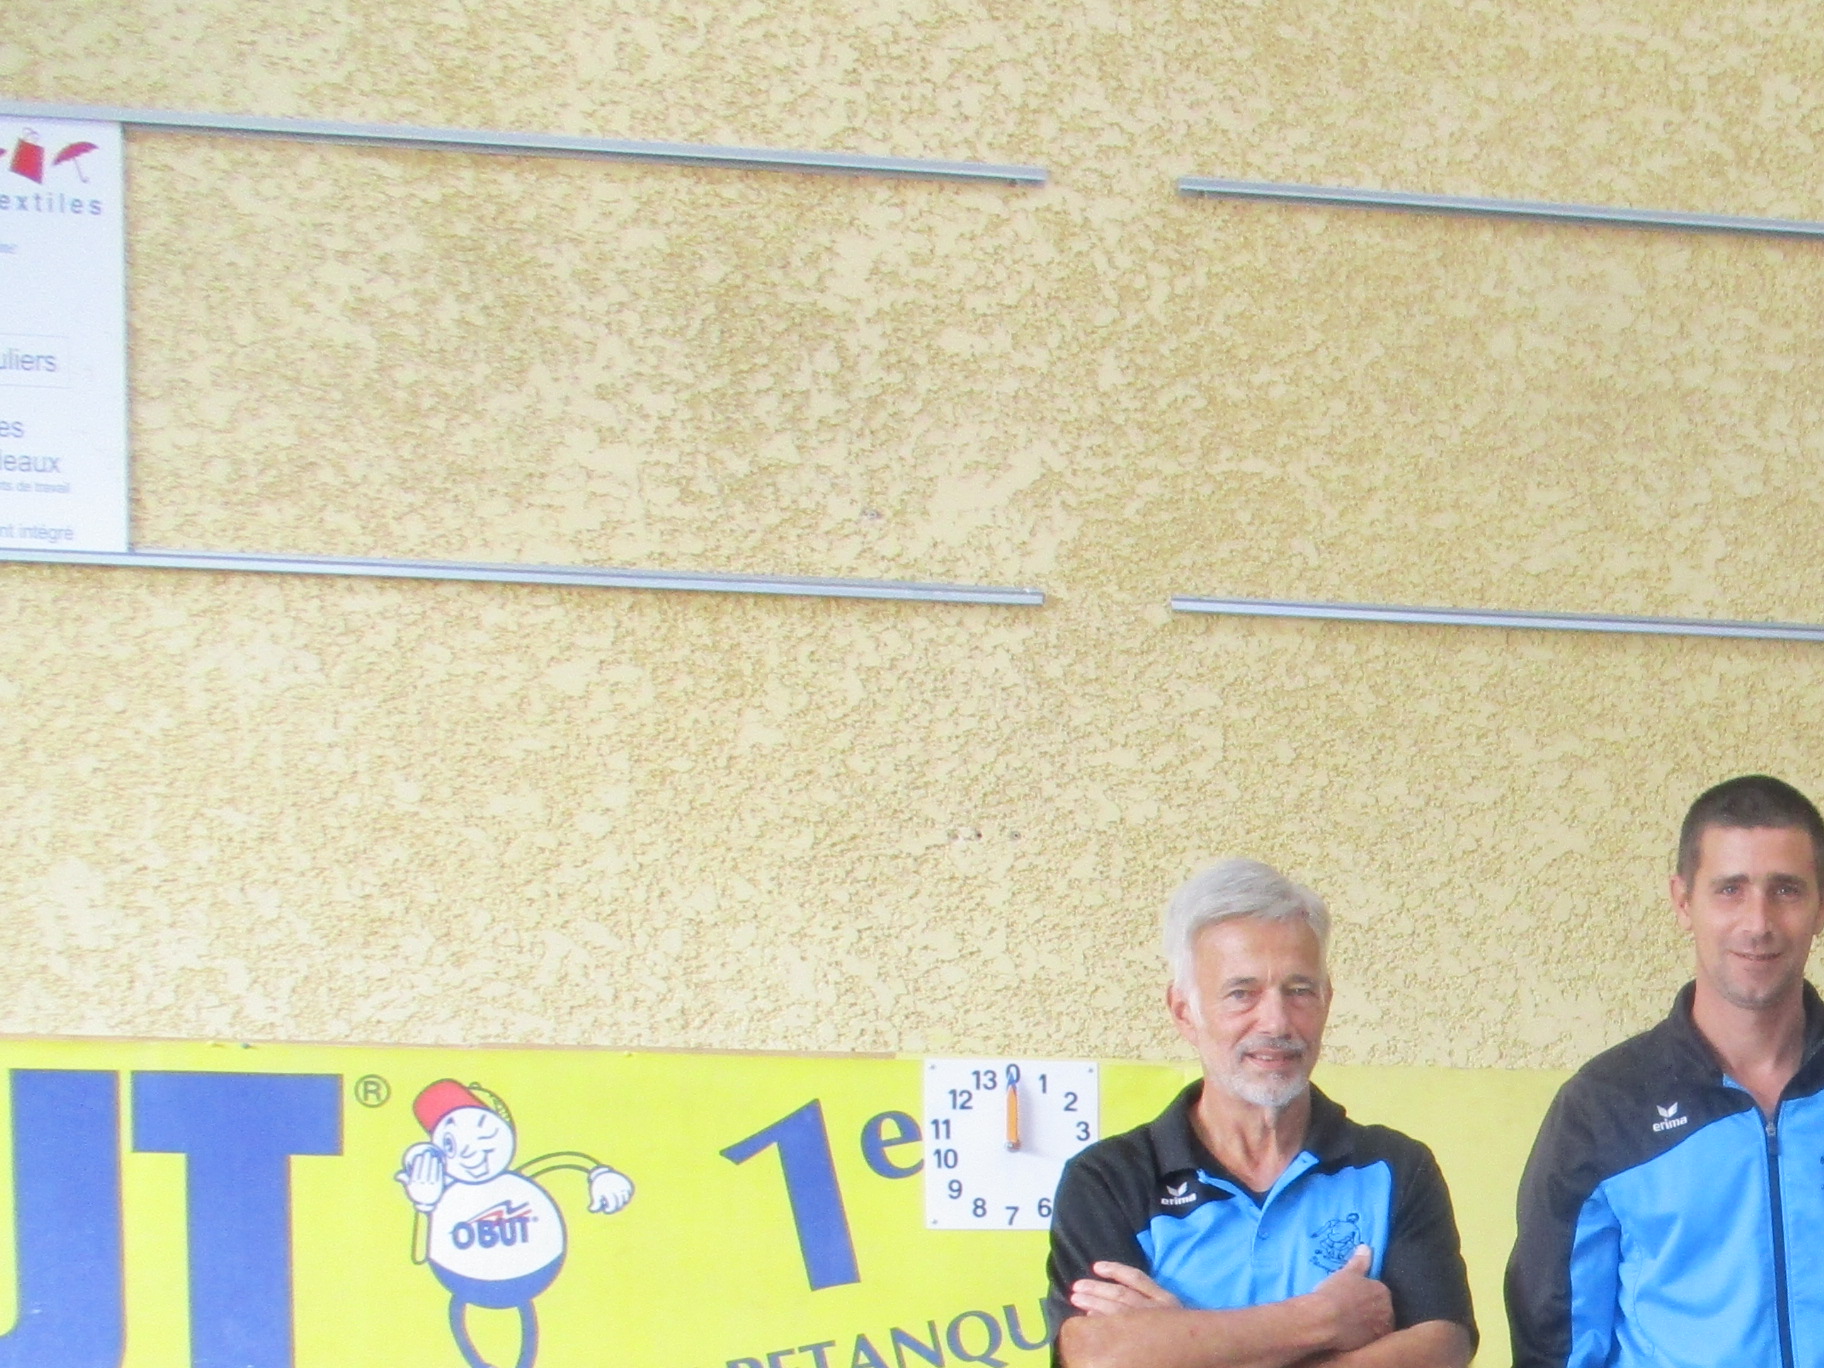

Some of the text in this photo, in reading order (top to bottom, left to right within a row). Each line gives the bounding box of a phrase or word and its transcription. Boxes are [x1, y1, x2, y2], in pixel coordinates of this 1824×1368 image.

[0, 449, 61, 473] eaux
[972, 1070, 998, 1090] 13
[1005, 1064, 1021, 1085] 0
[1038, 1074, 1047, 1094] 1
[948, 1089, 973, 1110] 12
[1063, 1092, 1078, 1112] 2
[930, 1118, 951, 1140] 11
[1076, 1121, 1090, 1141] 3
[1652, 1114, 1688, 1132] erima
[933, 1148, 958, 1169] 10
[948, 1179, 962, 1199] 9
[1161, 1193, 1197, 1205] erima
[972, 1197, 987, 1217] 8
[1005, 1206, 1019, 1226] 7
[1037, 1198, 1052, 1218] 6
[450, 1216, 531, 1251] OBUT
